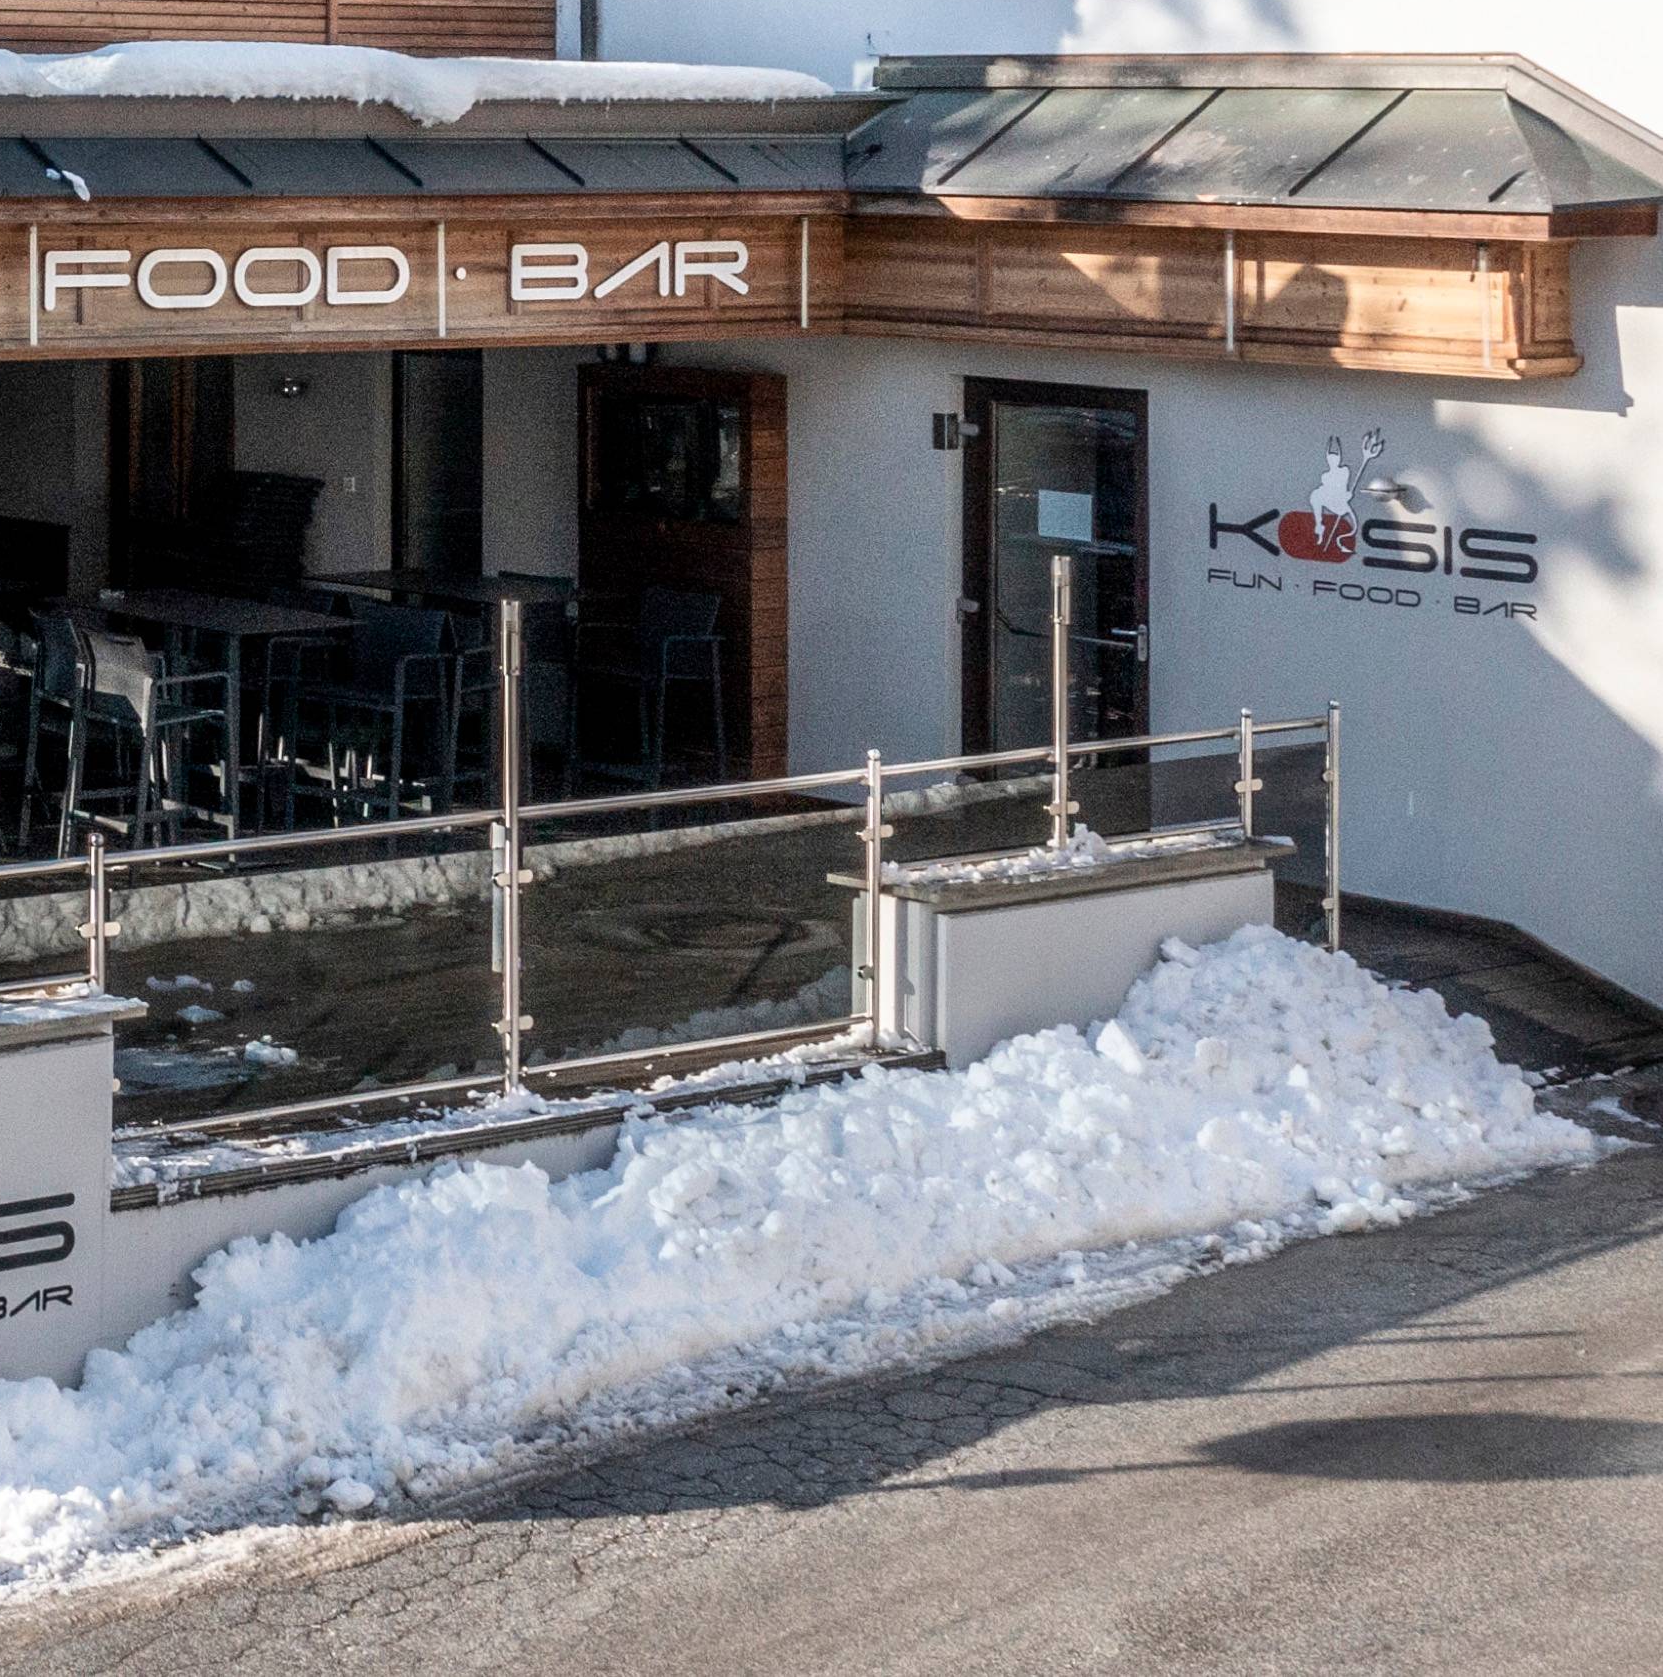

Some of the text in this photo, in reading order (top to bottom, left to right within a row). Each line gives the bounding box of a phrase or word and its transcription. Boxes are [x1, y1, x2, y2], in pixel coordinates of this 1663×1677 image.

[44, 246, 409, 315] FOOD
[510, 240, 750, 303] BAR
[1209, 502, 1538, 584] KOSIS
[1208, 569, 1539, 622] FUN FOOD BAR
